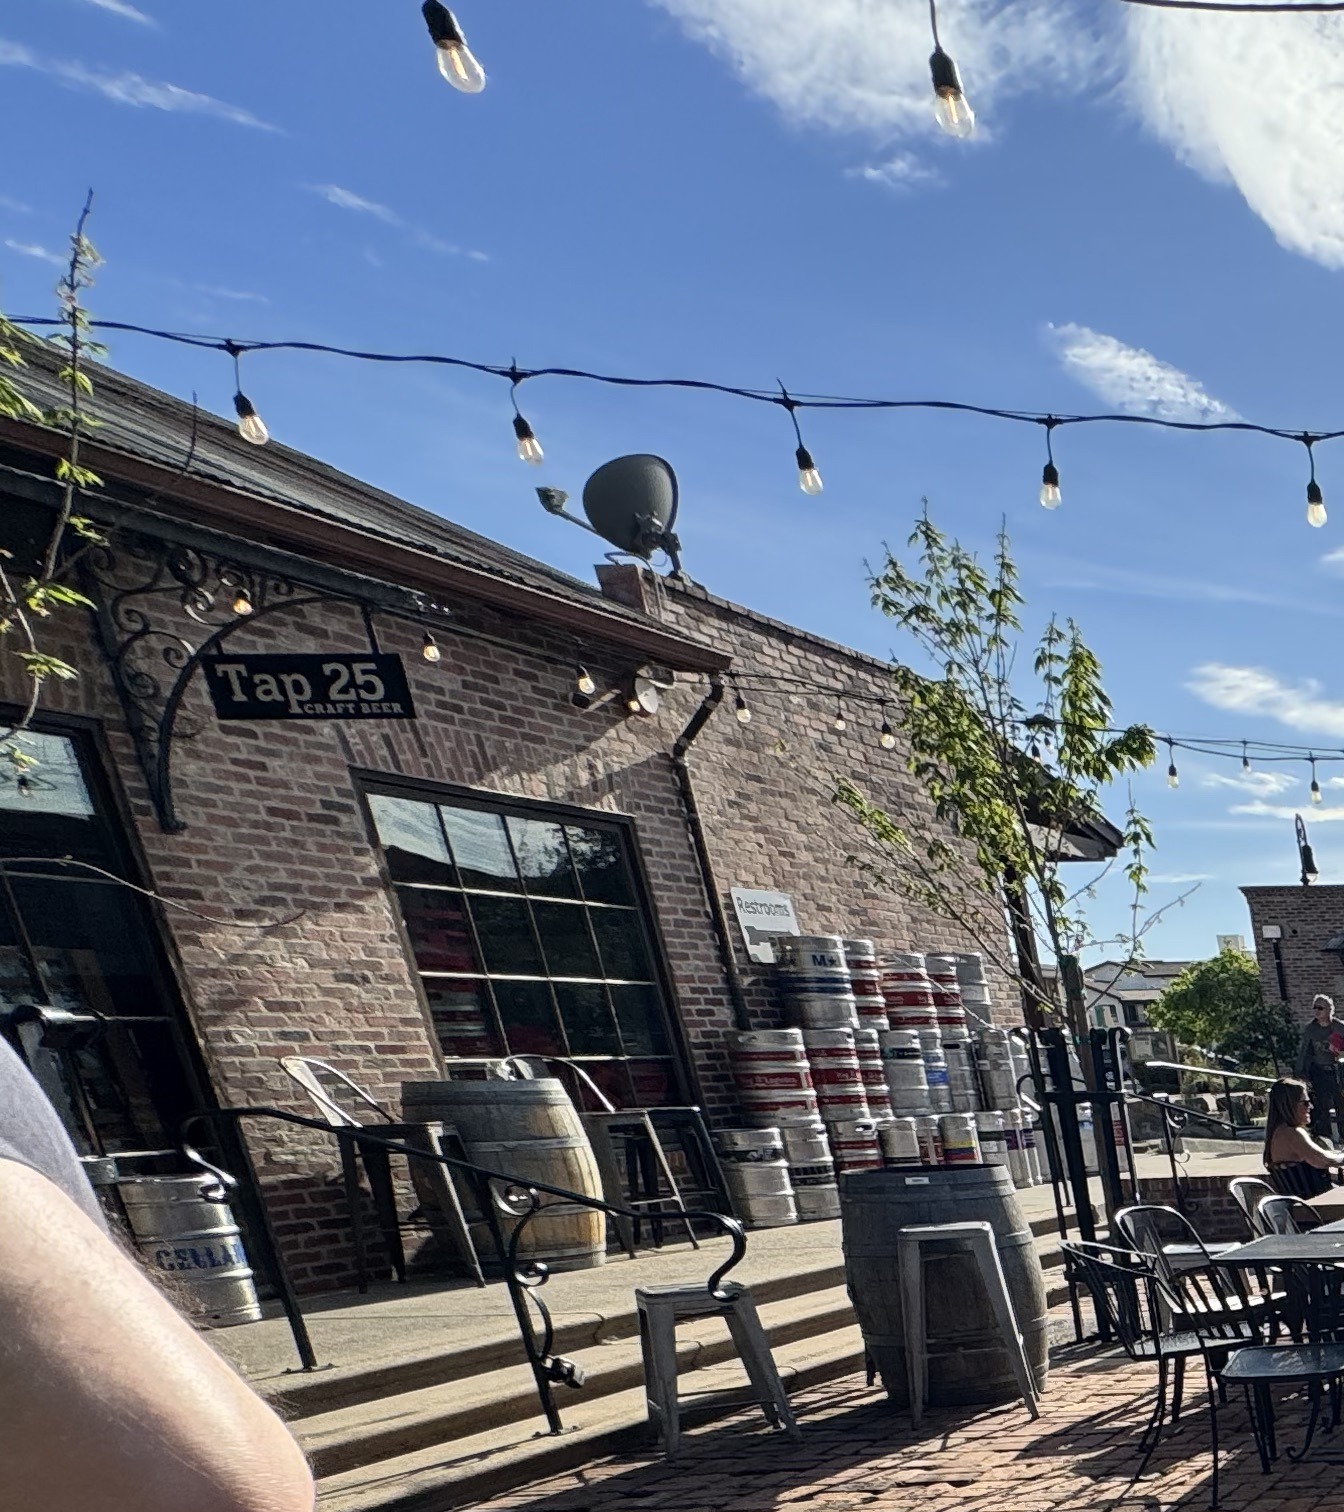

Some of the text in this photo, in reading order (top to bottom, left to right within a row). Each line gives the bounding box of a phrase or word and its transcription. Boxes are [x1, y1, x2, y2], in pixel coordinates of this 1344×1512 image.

[214, 662, 385, 714] Tap 25
[303, 702, 404, 714] CRAFT BEER
[736, 896, 791, 917] Restrooms
